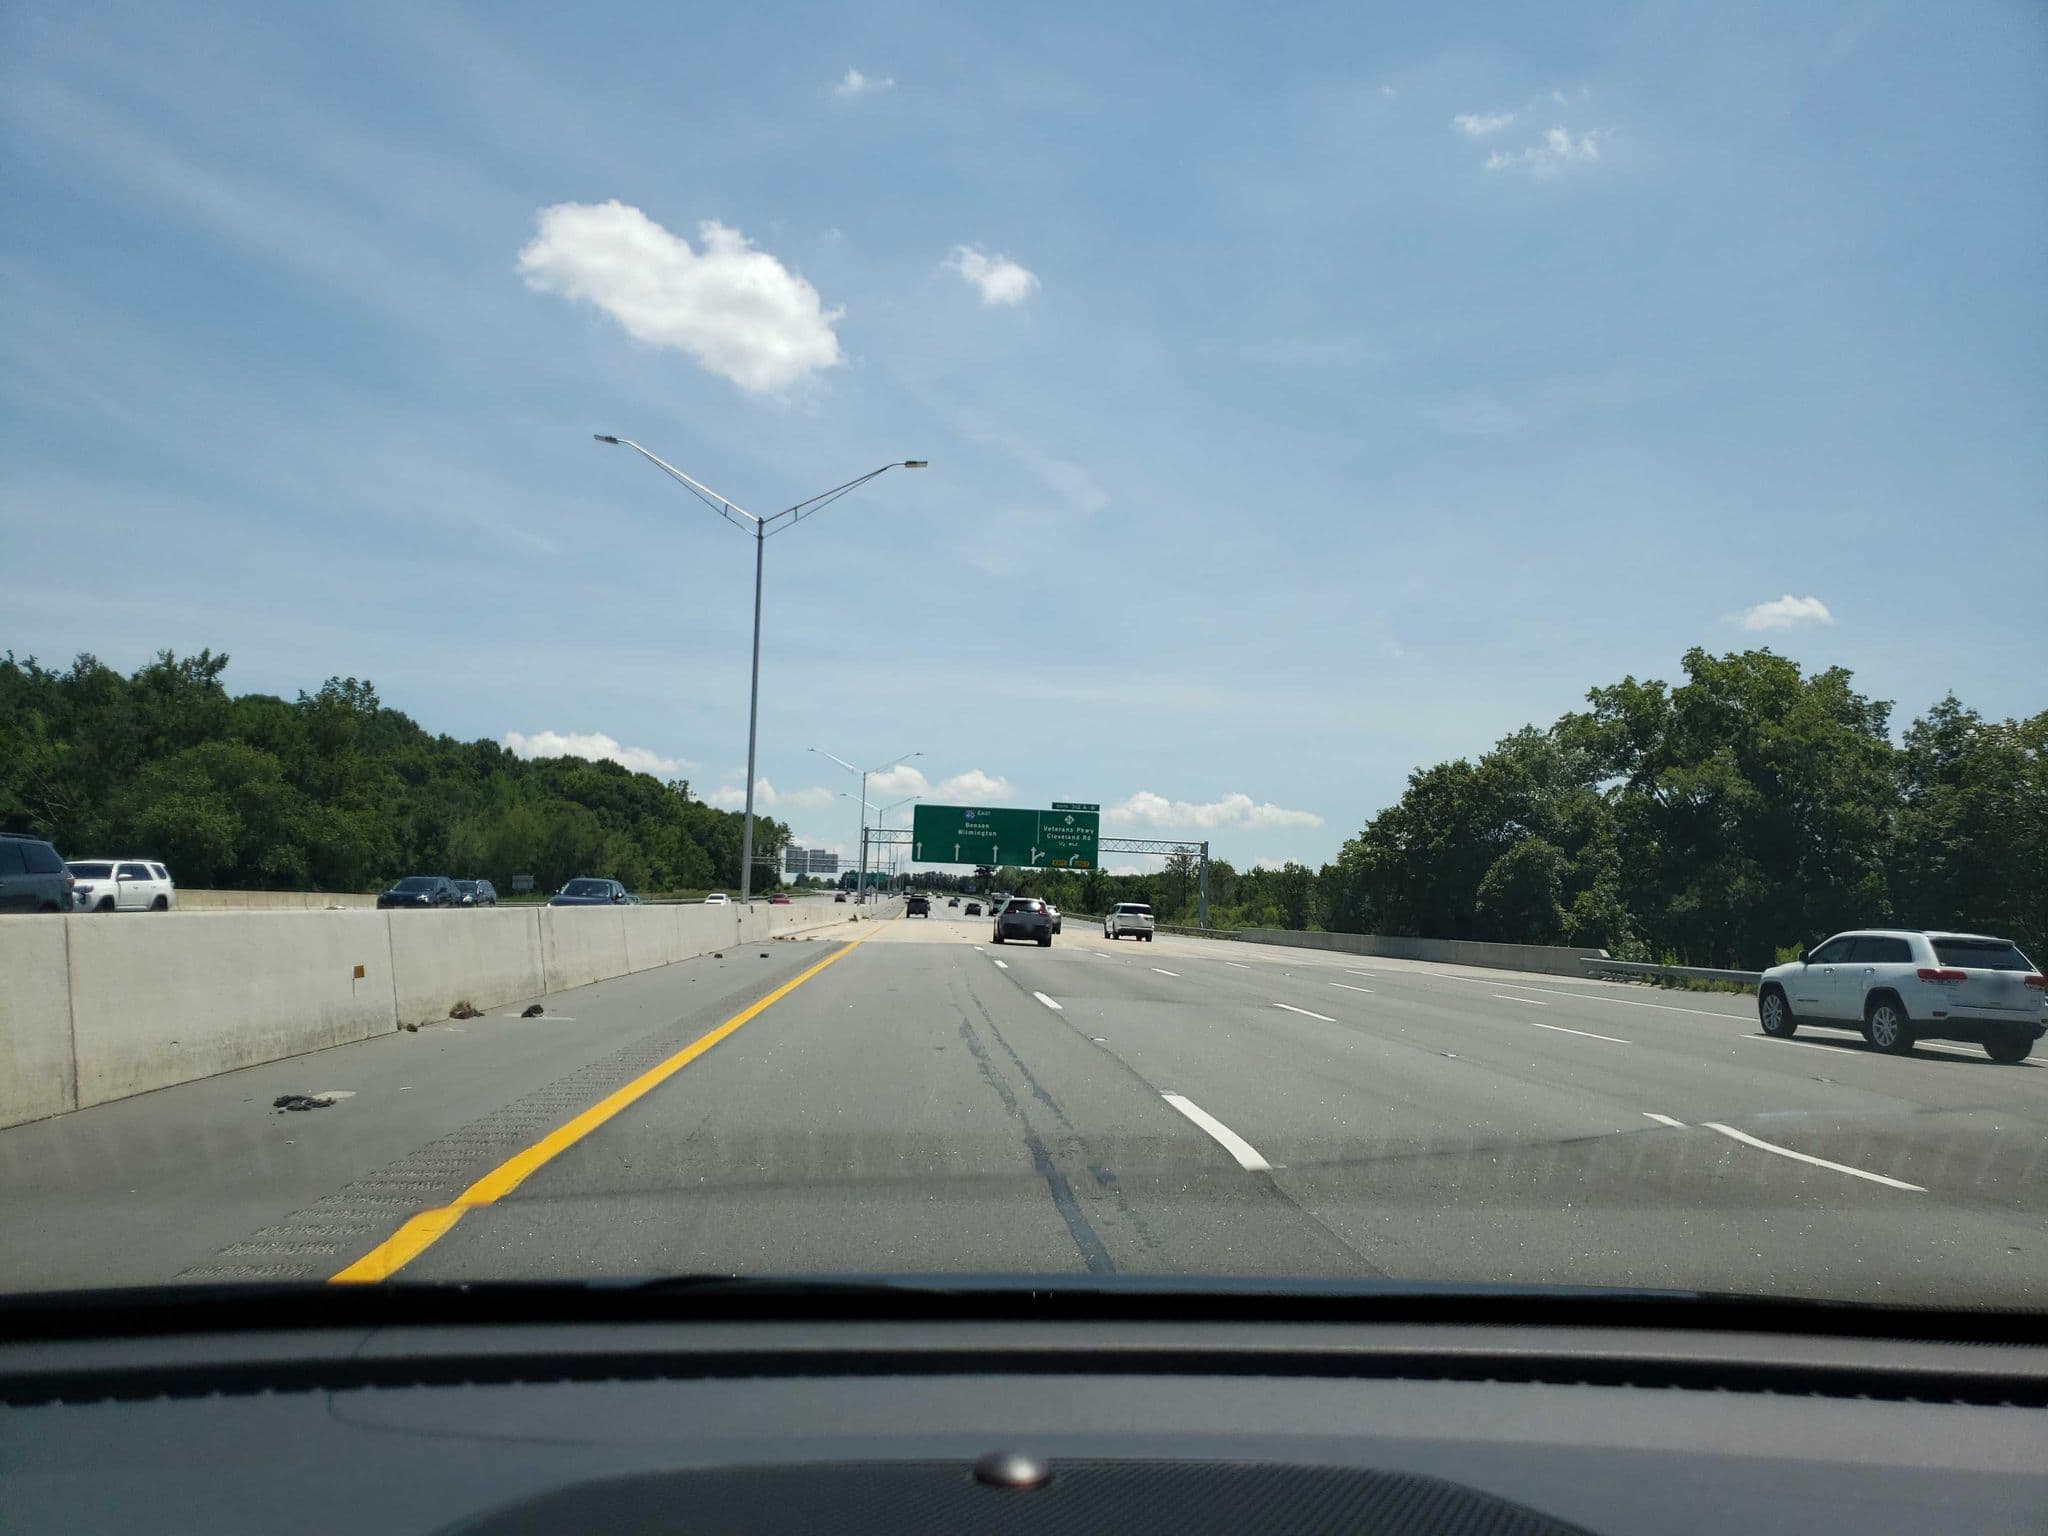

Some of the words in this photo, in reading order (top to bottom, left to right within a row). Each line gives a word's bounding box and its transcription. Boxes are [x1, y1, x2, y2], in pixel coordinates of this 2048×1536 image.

[958, 829, 997, 838] Wilmington
[1043, 825, 1074, 833] Veterans
[1076, 827, 1094, 835] Pkwy
[1046, 833, 1080, 841] Cleveland
